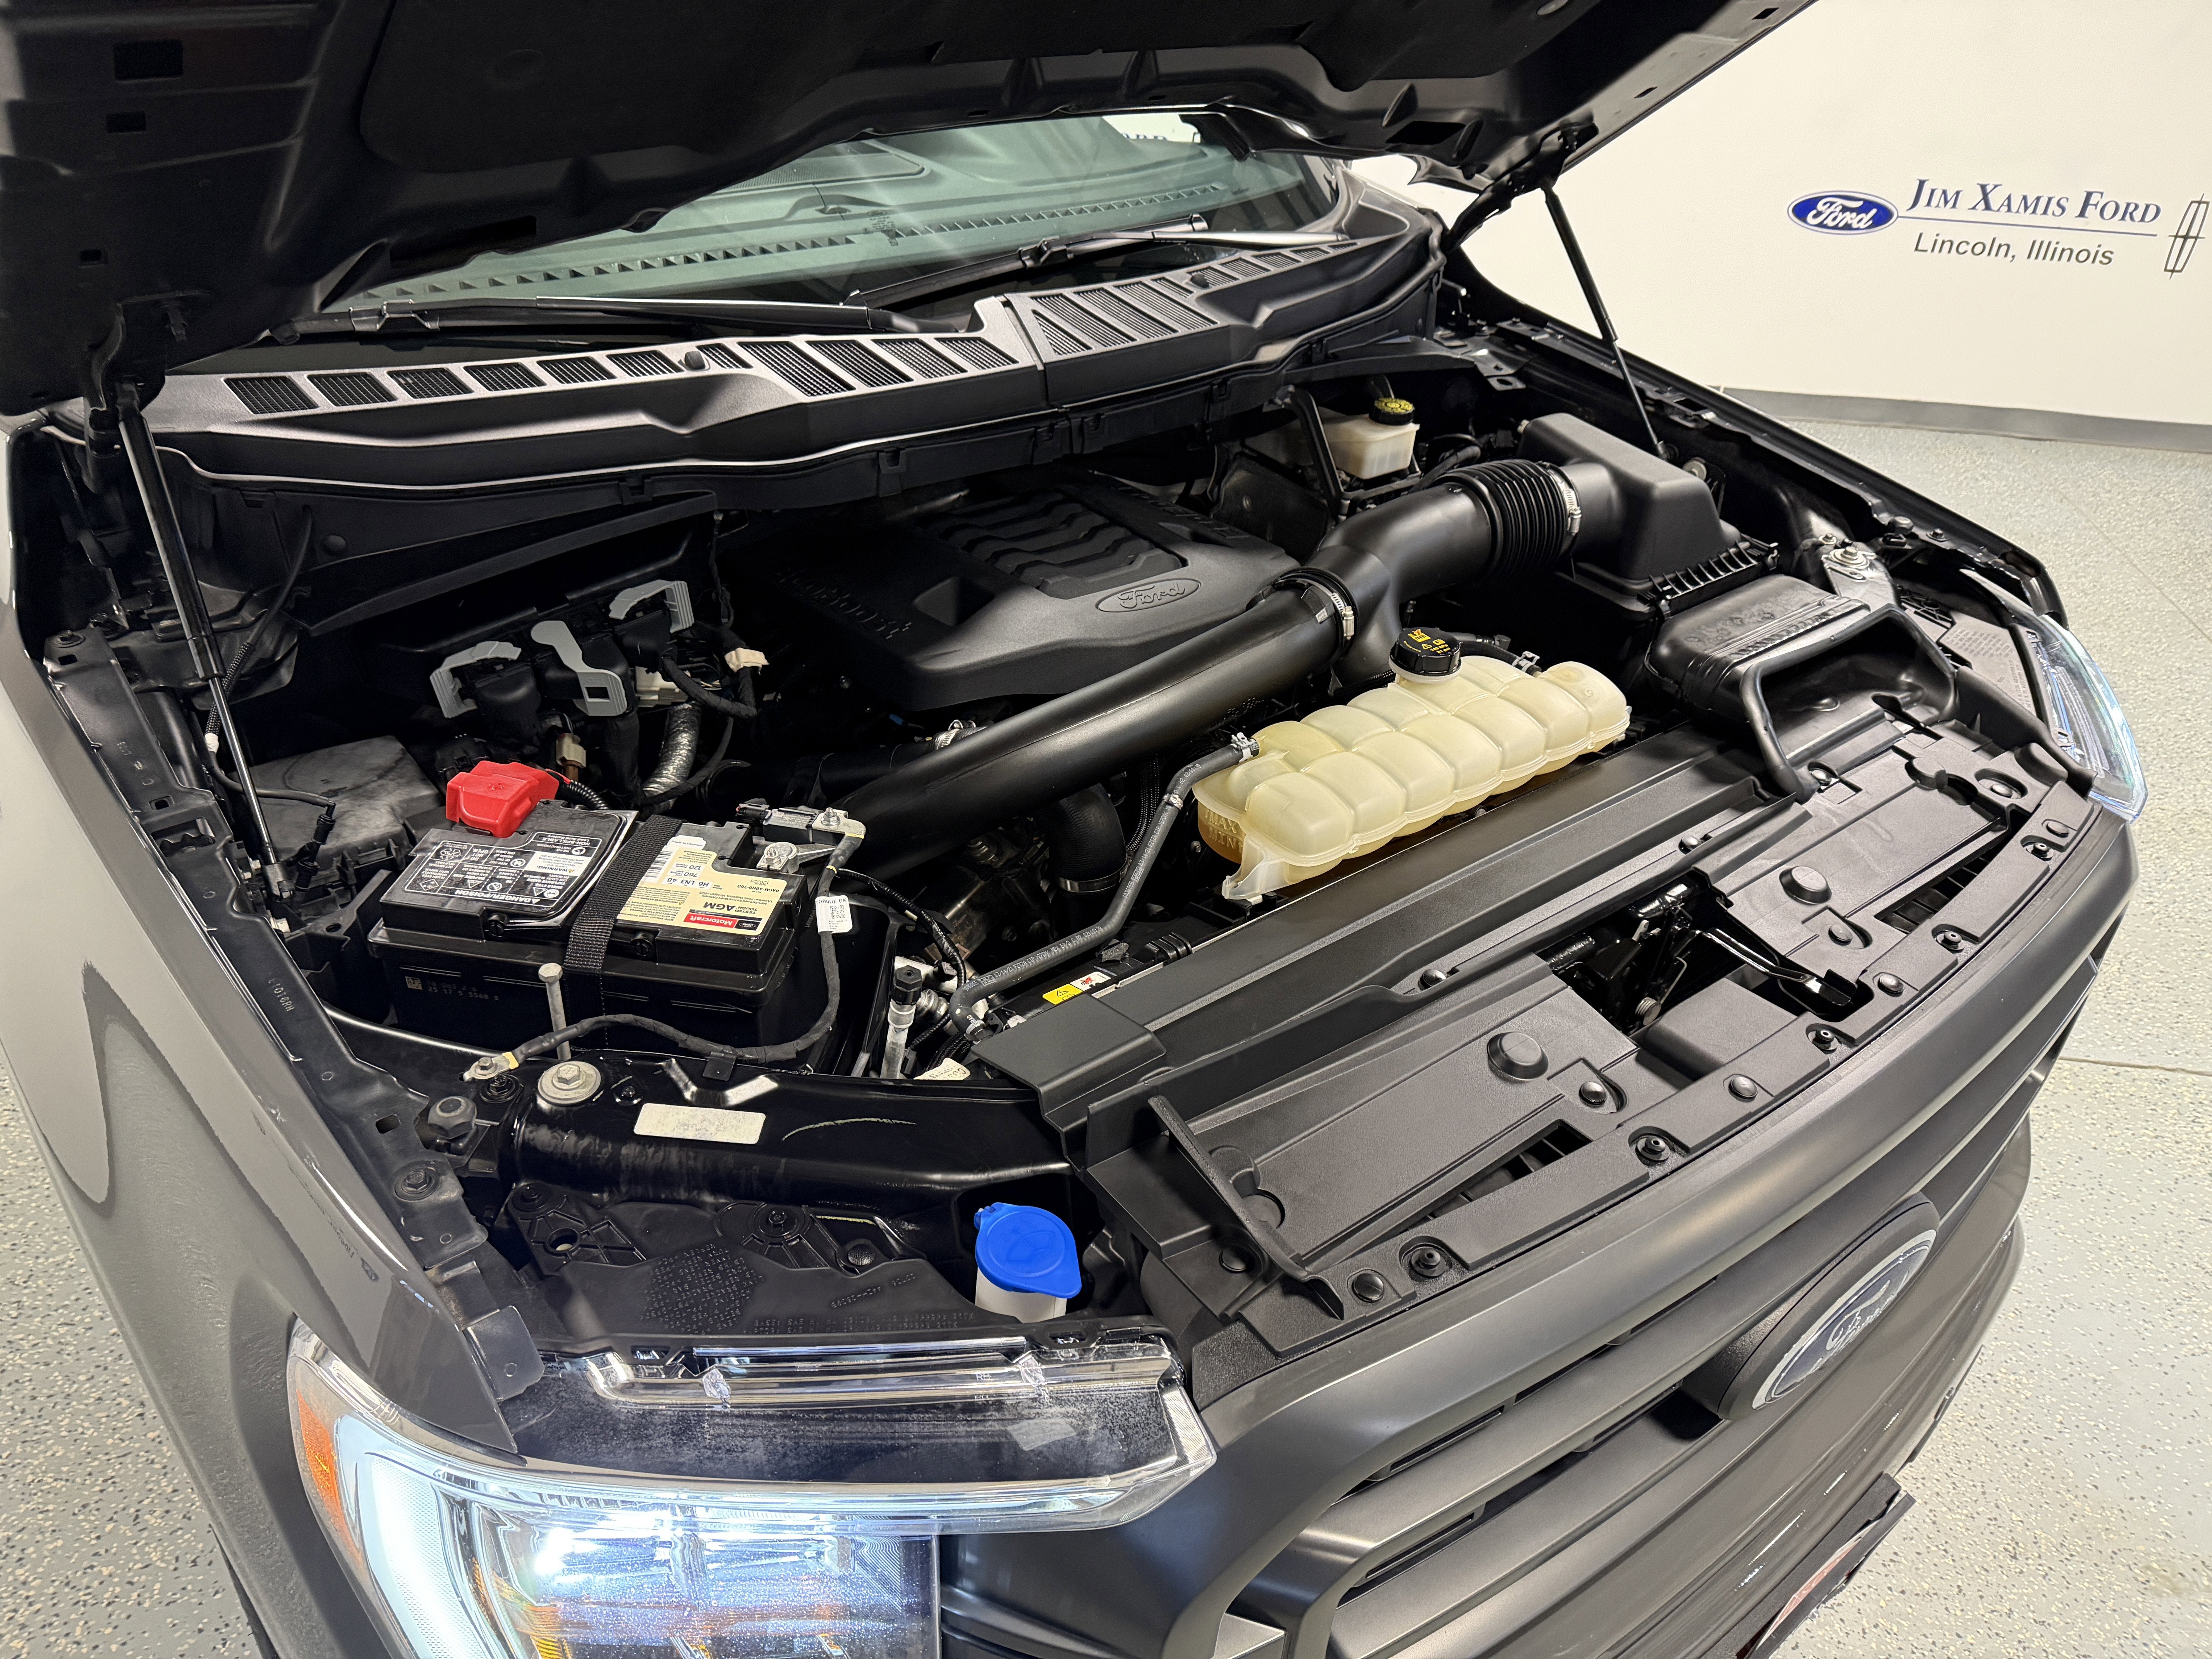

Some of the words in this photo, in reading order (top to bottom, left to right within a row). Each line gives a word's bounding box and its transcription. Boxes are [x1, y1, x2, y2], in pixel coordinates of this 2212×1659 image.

[1906, 179, 1963, 211] JIM
[1968, 182, 2069, 218] XAMIS
[2075, 190, 2162, 224] FORD
[1808, 195, 1874, 230] Ford
[1914, 232, 2017, 263] Lincoln,
[2027, 235, 2116, 266] Illinois
[1118, 582, 1185, 609] Ford
[542, 837, 591, 846] NON-SPILLABLE
[455, 890, 531, 903] DANGER/POISON
[703, 902, 736, 911] AGM
[690, 915, 733, 926] Motorcraft
